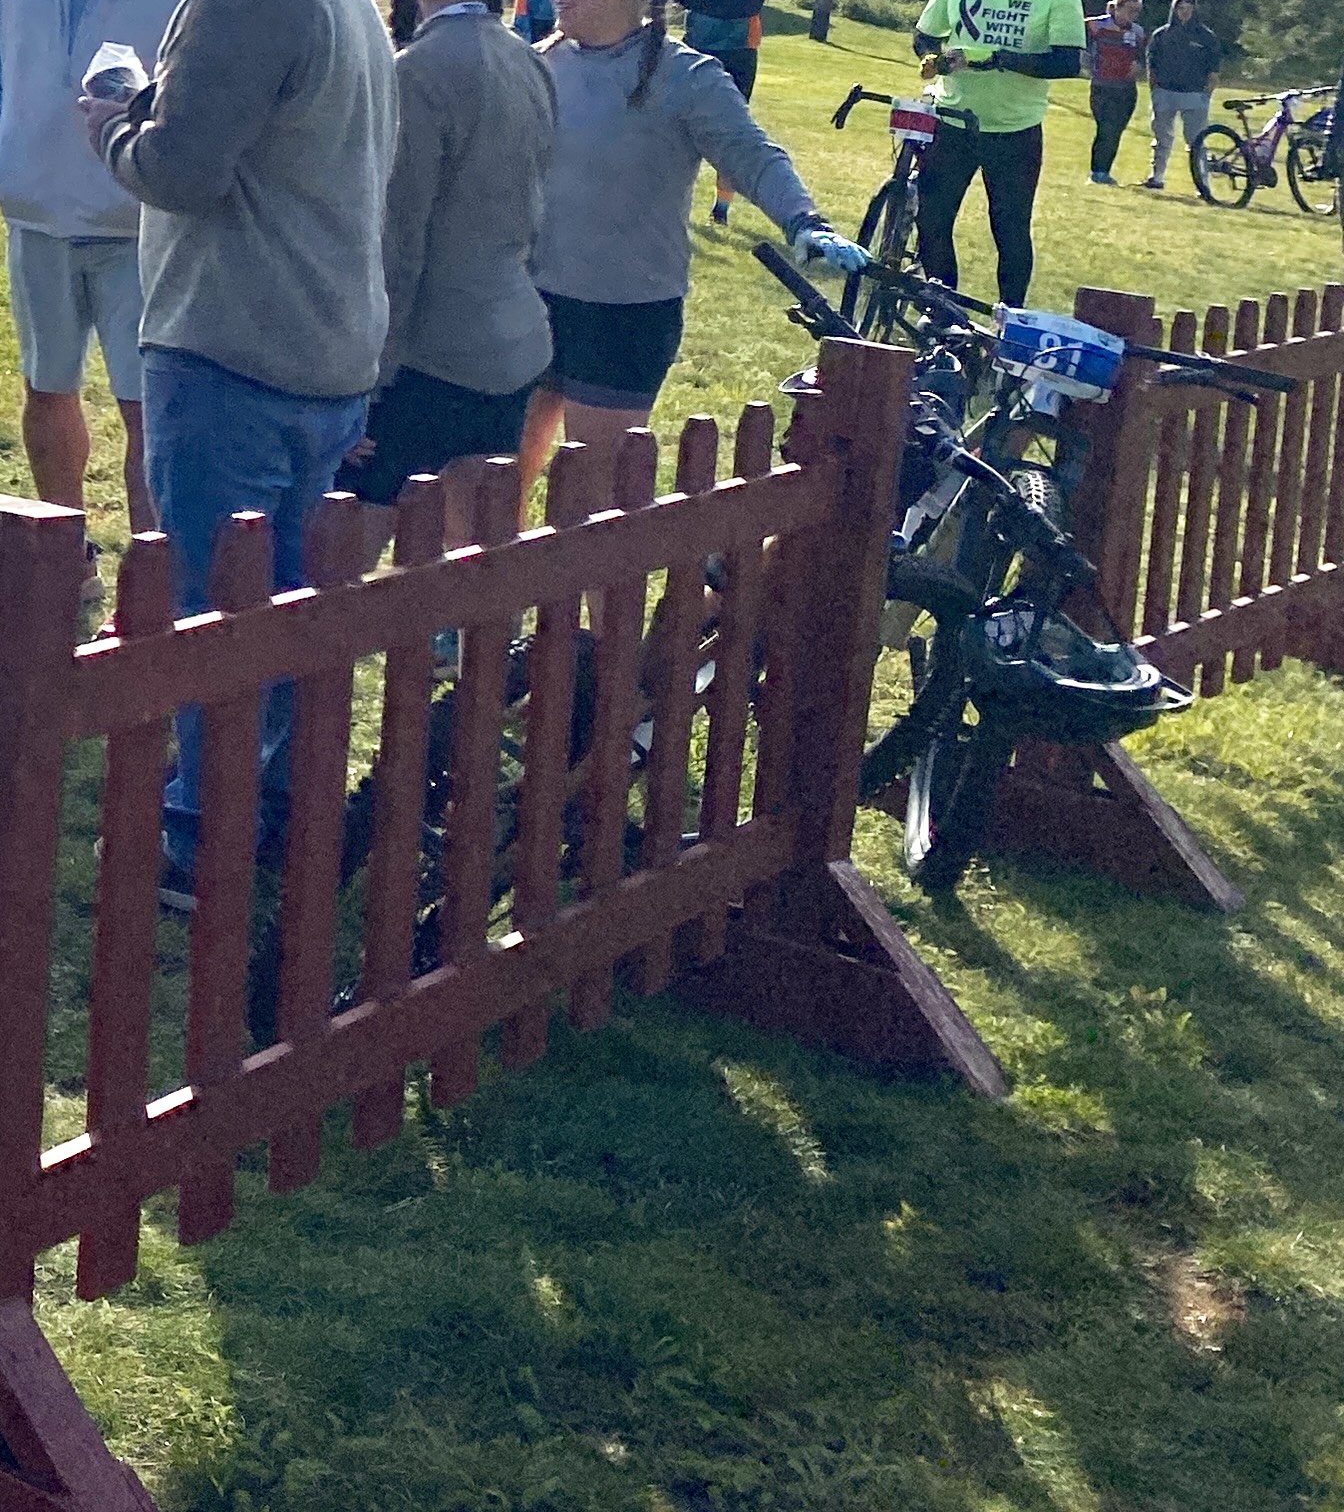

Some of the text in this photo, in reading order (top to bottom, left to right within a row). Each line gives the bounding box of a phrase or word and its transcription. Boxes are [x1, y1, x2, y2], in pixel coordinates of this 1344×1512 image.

[1008, 0, 1033, 12] WE
[981, 8, 1030, 23] FIGHT
[986, 21, 1026, 37] WITH
[983, 34, 1024, 49] DALE
